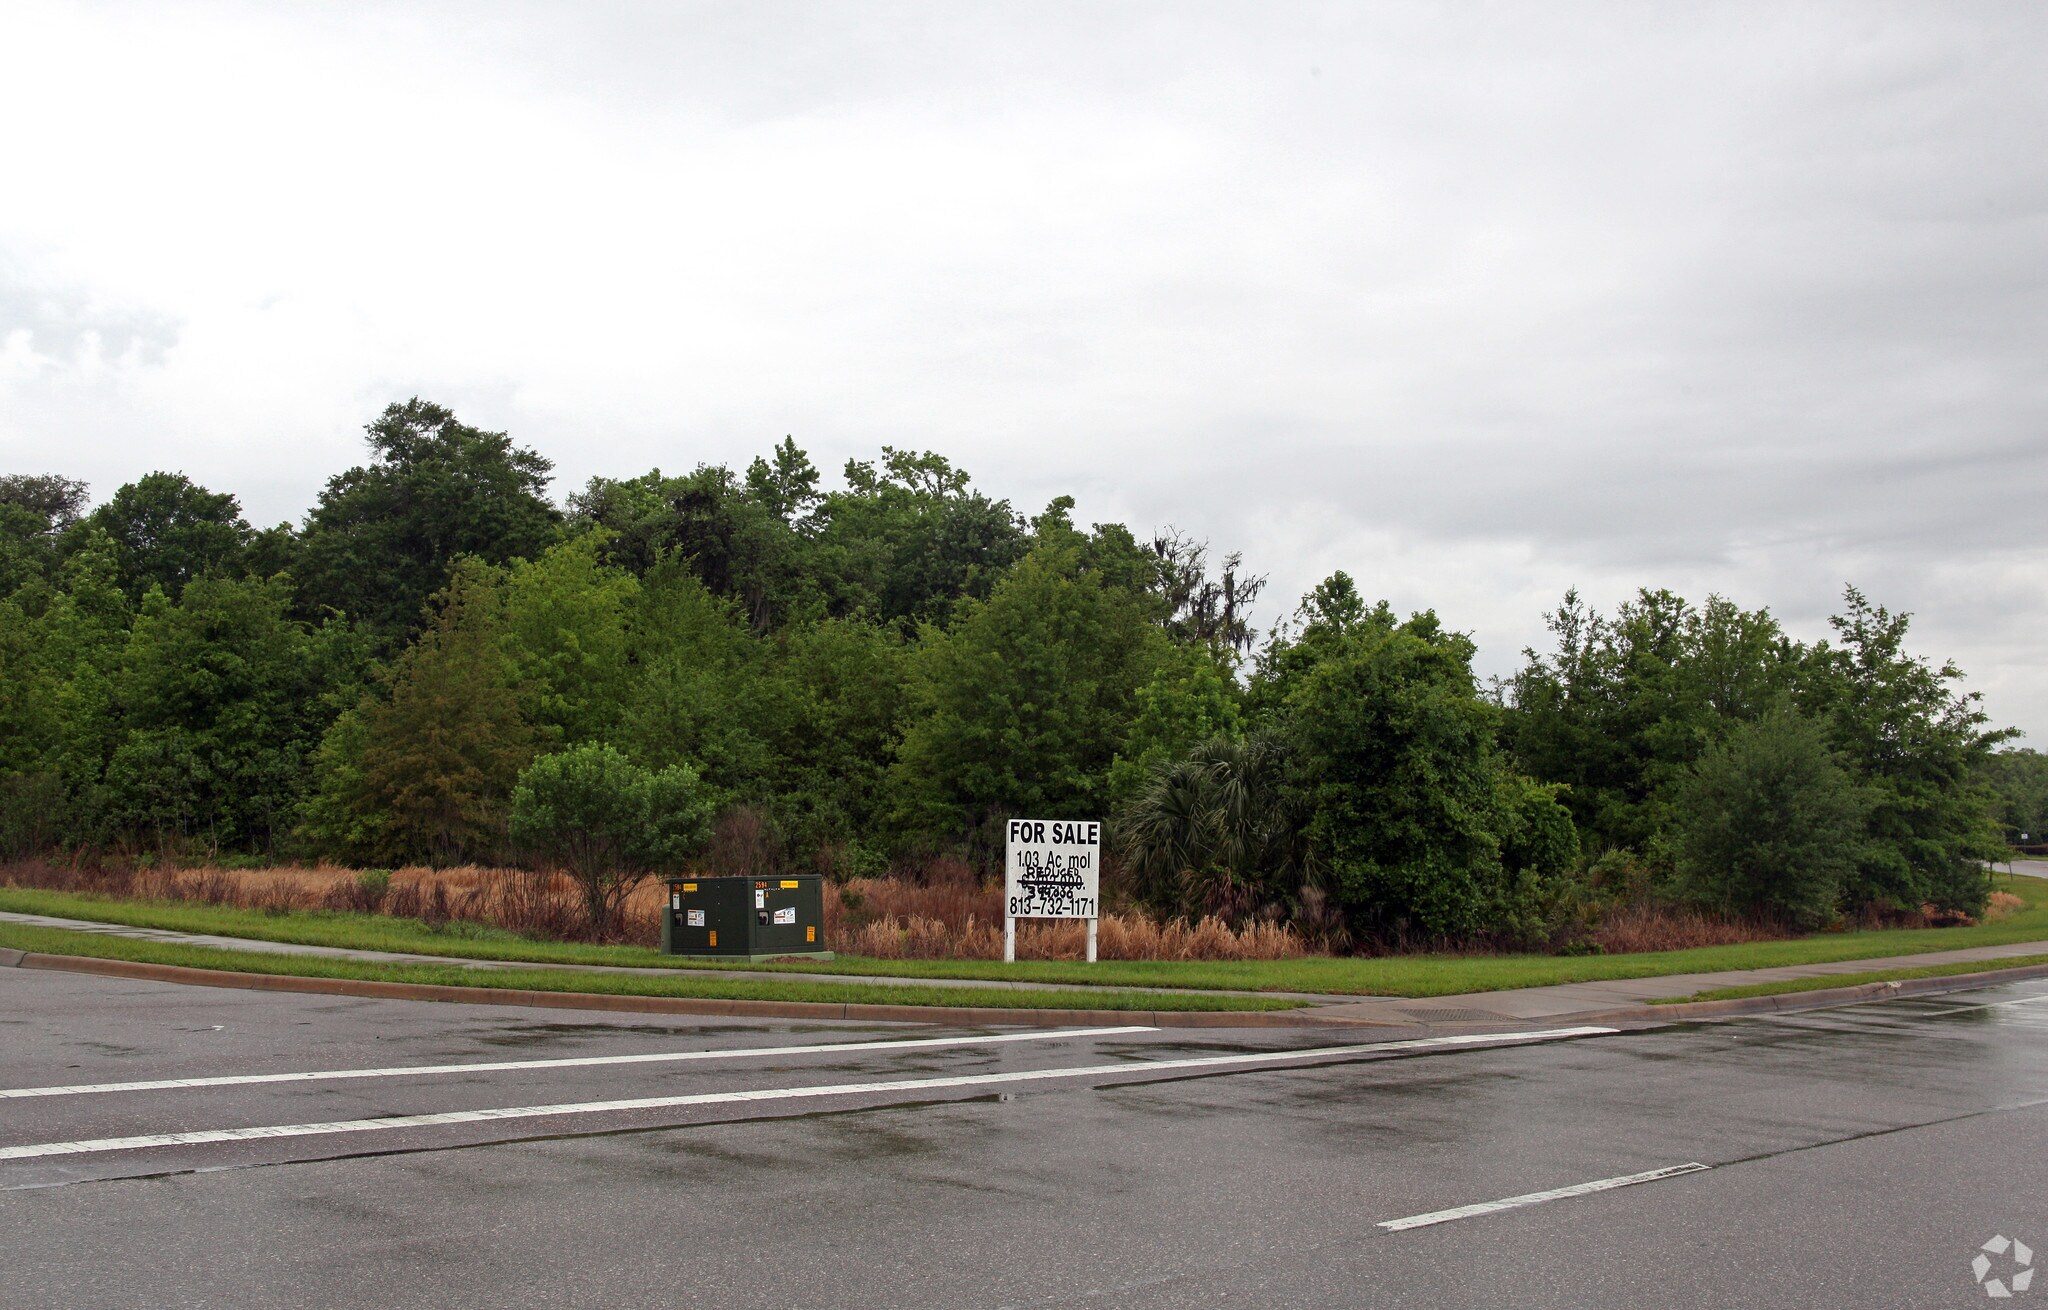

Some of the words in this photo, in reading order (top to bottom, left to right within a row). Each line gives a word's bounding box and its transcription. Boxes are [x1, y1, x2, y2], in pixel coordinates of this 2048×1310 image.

[1010, 822, 1045, 844] FOR
[1052, 823, 1098, 845] SALE
[1017, 850, 1039, 868] 1.03
[1046, 850, 1062, 869] Ac
[1069, 851, 1090, 869] mol
[1026, 866, 1079, 880] REDUCED
[1010, 897, 1094, 915] 813-732-1171
